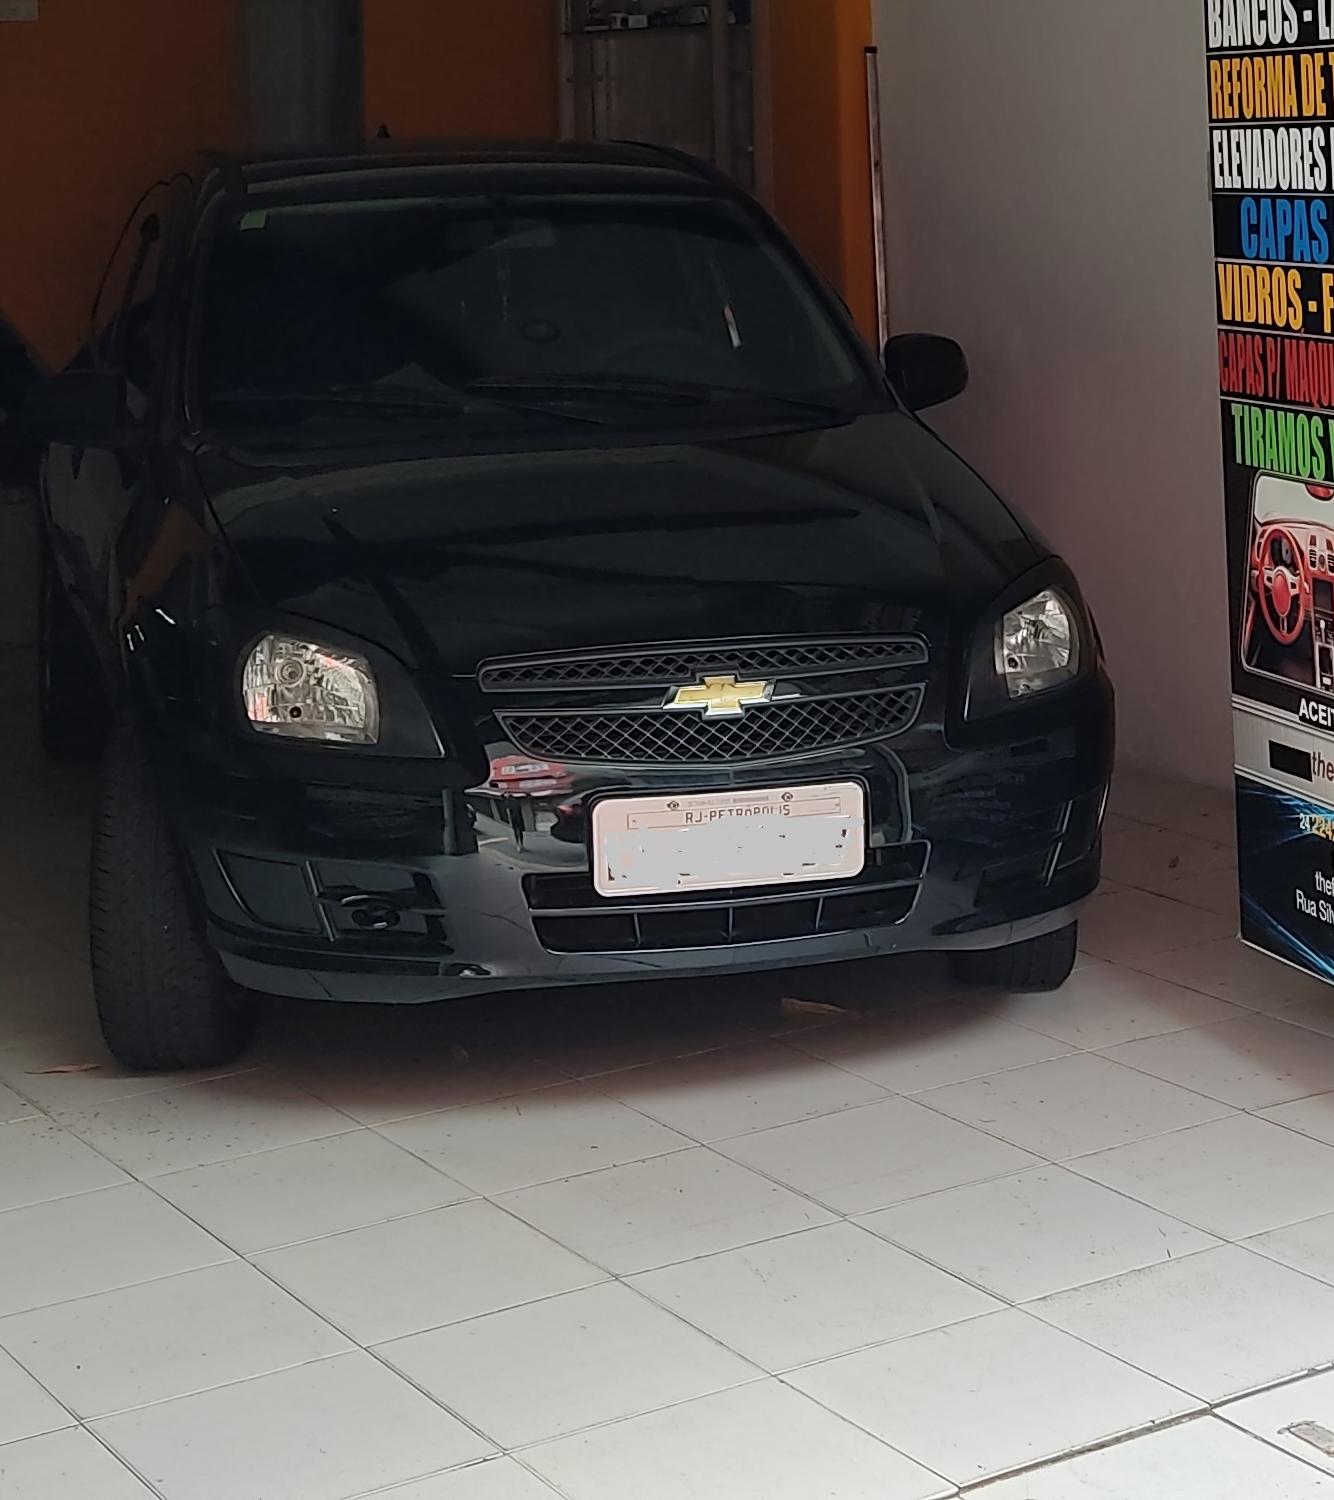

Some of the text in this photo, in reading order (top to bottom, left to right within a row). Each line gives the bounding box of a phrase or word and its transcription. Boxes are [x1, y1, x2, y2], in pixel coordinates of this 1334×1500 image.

[1210, 55, 1298, 119] REFORMA
[1302, 52, 1327, 117] DE
[1212, 127, 1326, 191] ELEVADORES
[1241, 197, 1329, 265] CAPAS
[1218, 263, 1303, 330] VIDROS
[1218, 331, 1264, 397] CAPAS
[1267, 338, 1282, 397] P/
[1231, 403, 1325, 480] TIRAMOS
[1300, 813, 1310, 831] 24
[1296, 889, 1317, 917] Rua
